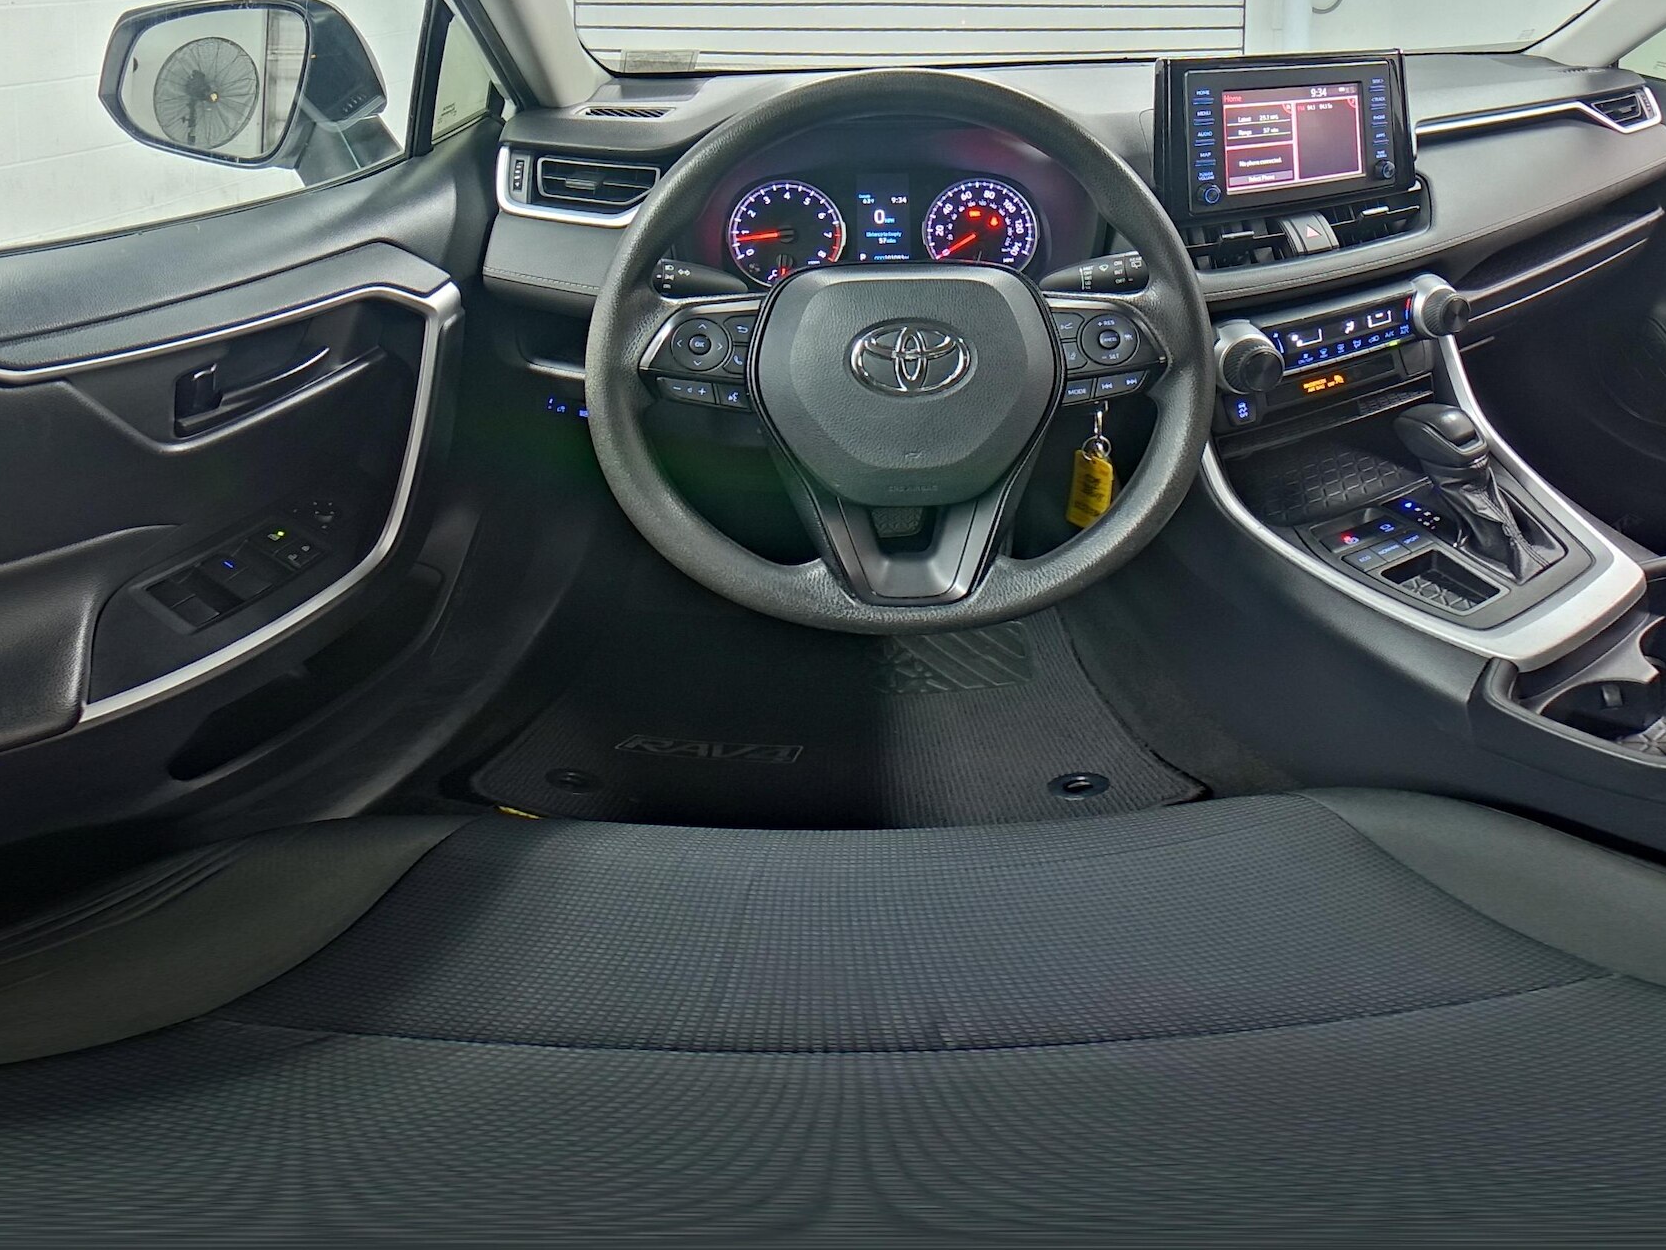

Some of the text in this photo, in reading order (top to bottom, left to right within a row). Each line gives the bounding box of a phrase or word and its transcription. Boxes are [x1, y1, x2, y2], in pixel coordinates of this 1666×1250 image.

[1310, 87, 1327, 98] 9:34
[1224, 95, 1243, 103] Home
[783, 192, 791, 200] 4
[961, 191, 972, 201] 60
[983, 190, 996, 200] 80
[763, 196, 771, 205] 3
[803, 197, 811, 205] 5
[943, 203, 953, 215] 40
[1003, 199, 1016, 213] 100
[747, 210, 756, 218] 2
[874, 209, 885, 224] 0
[935, 224, 945, 236] 20
[1014, 218, 1024, 234] 120
[746, 248, 754, 256] 0
[817, 250, 826, 258] 8
[1010, 242, 1022, 256] 140
[860, 253, 867, 261] P
